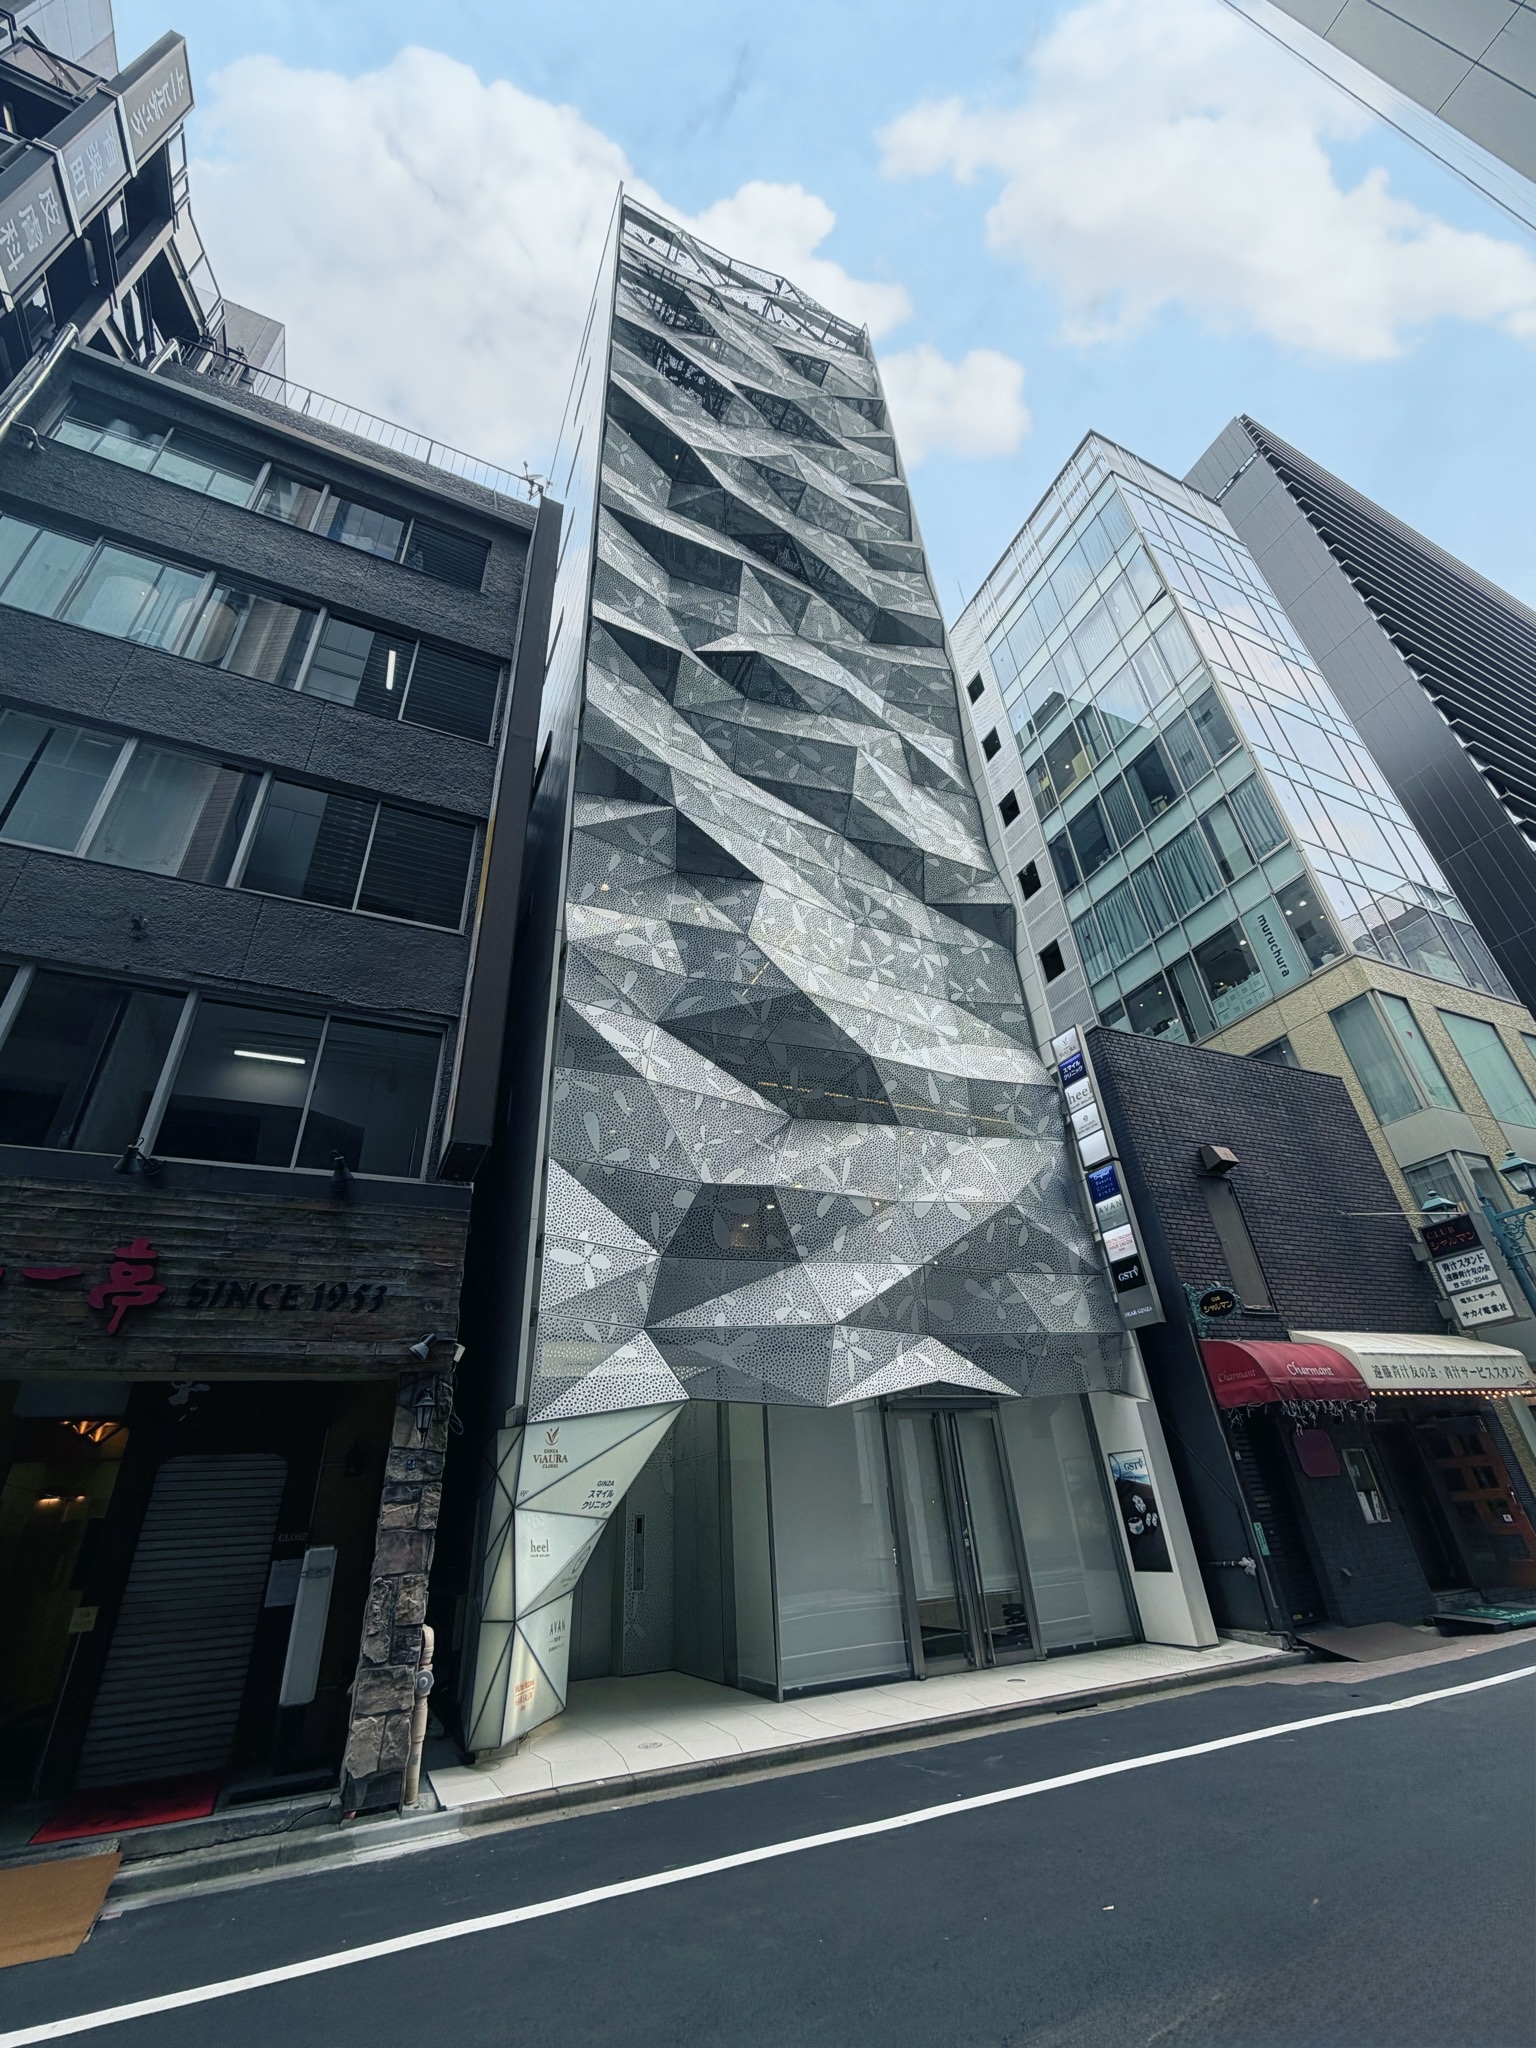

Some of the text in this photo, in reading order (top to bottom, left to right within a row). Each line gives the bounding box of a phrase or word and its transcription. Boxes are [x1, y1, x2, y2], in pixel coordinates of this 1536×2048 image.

[69, 125, 120, 201] 有楽町
[0, 187, 61, 272] 皮膚科
[1257, 914, 1290, 977] muruchura
[1063, 1060, 1080, 1074] スマイル
[1064, 1066, 1083, 1080] クリニック
[1067, 1080, 1092, 1104] heel
[1099, 1199, 1122, 1214] AVAN
[1426, 1225, 1455, 1240] CLUB
[1430, 1231, 1476, 1251] シャルマン
[1441, 1252, 1485, 1273] 青汁スタンド
[1118, 1267, 1138, 1281] GSTV
[1444, 1264, 1491, 1282] 遠藤青汁友の会
[187, 1279, 388, 1313] SINCE 1953
[1137, 1305, 1153, 1314] GINZA
[1203, 1301, 1233, 1313] シャルマン
[1462, 1302, 1508, 1319] サカイ電業社
[1218, 1369, 1256, 1383] Charmant
[1286, 1361, 1334, 1377] Charmant
[1124, 1460, 1144, 1471] GSTV
[588, 1490, 615, 1498] スマイル
[581, 1501, 612, 1509] クリニック
[530, 1539, 549, 1552] heel
[549, 1619, 566, 1636] AVAN
